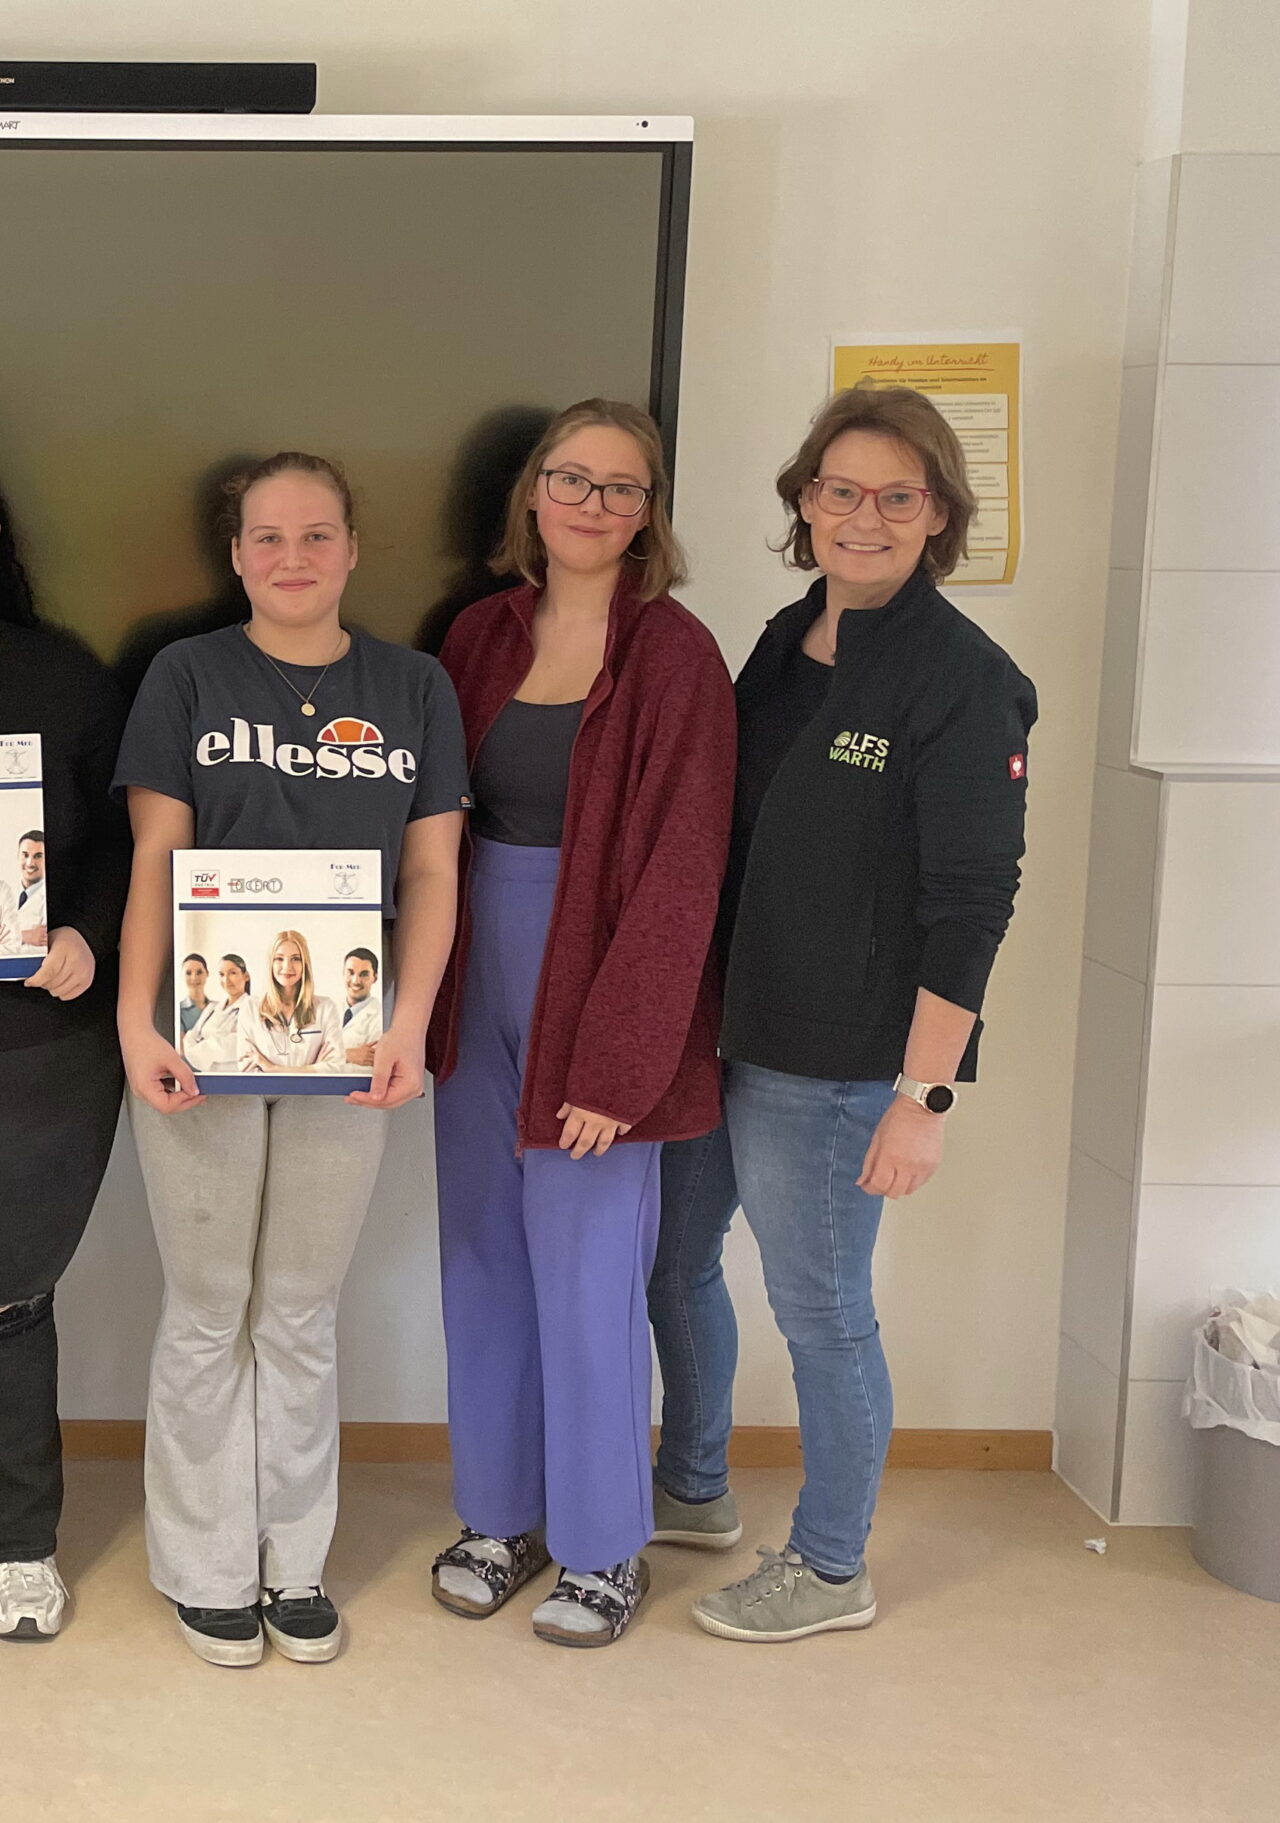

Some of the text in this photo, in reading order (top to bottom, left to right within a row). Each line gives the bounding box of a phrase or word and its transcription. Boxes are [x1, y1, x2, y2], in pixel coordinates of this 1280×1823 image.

[867, 355, 905, 373] Handy
[925, 352, 990, 367] Unterricht
[196, 717, 417, 784] ellesse
[849, 732, 890, 757] LFS
[829, 746, 886, 773] WARTH
[195, 873, 217, 883] TÜV
